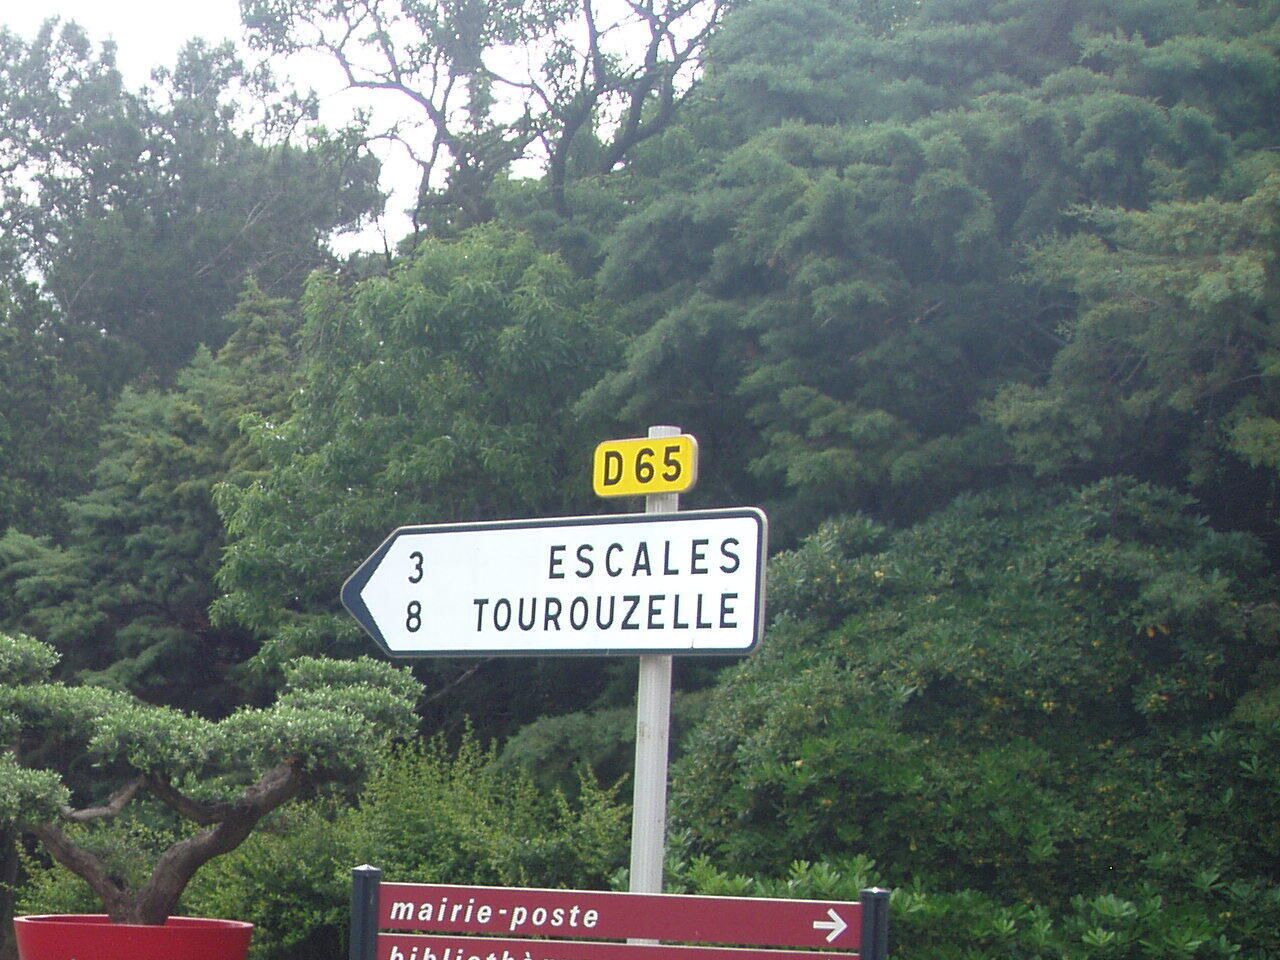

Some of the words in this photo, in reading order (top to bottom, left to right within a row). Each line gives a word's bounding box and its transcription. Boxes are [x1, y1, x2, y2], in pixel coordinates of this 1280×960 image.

[408, 551, 424, 584] 3
[548, 537, 740, 579] ESCALES
[405, 600, 422, 633] 8
[473, 592, 738, 632] TOUROUZELLE
[390, 897, 599, 930] mairie-poste
